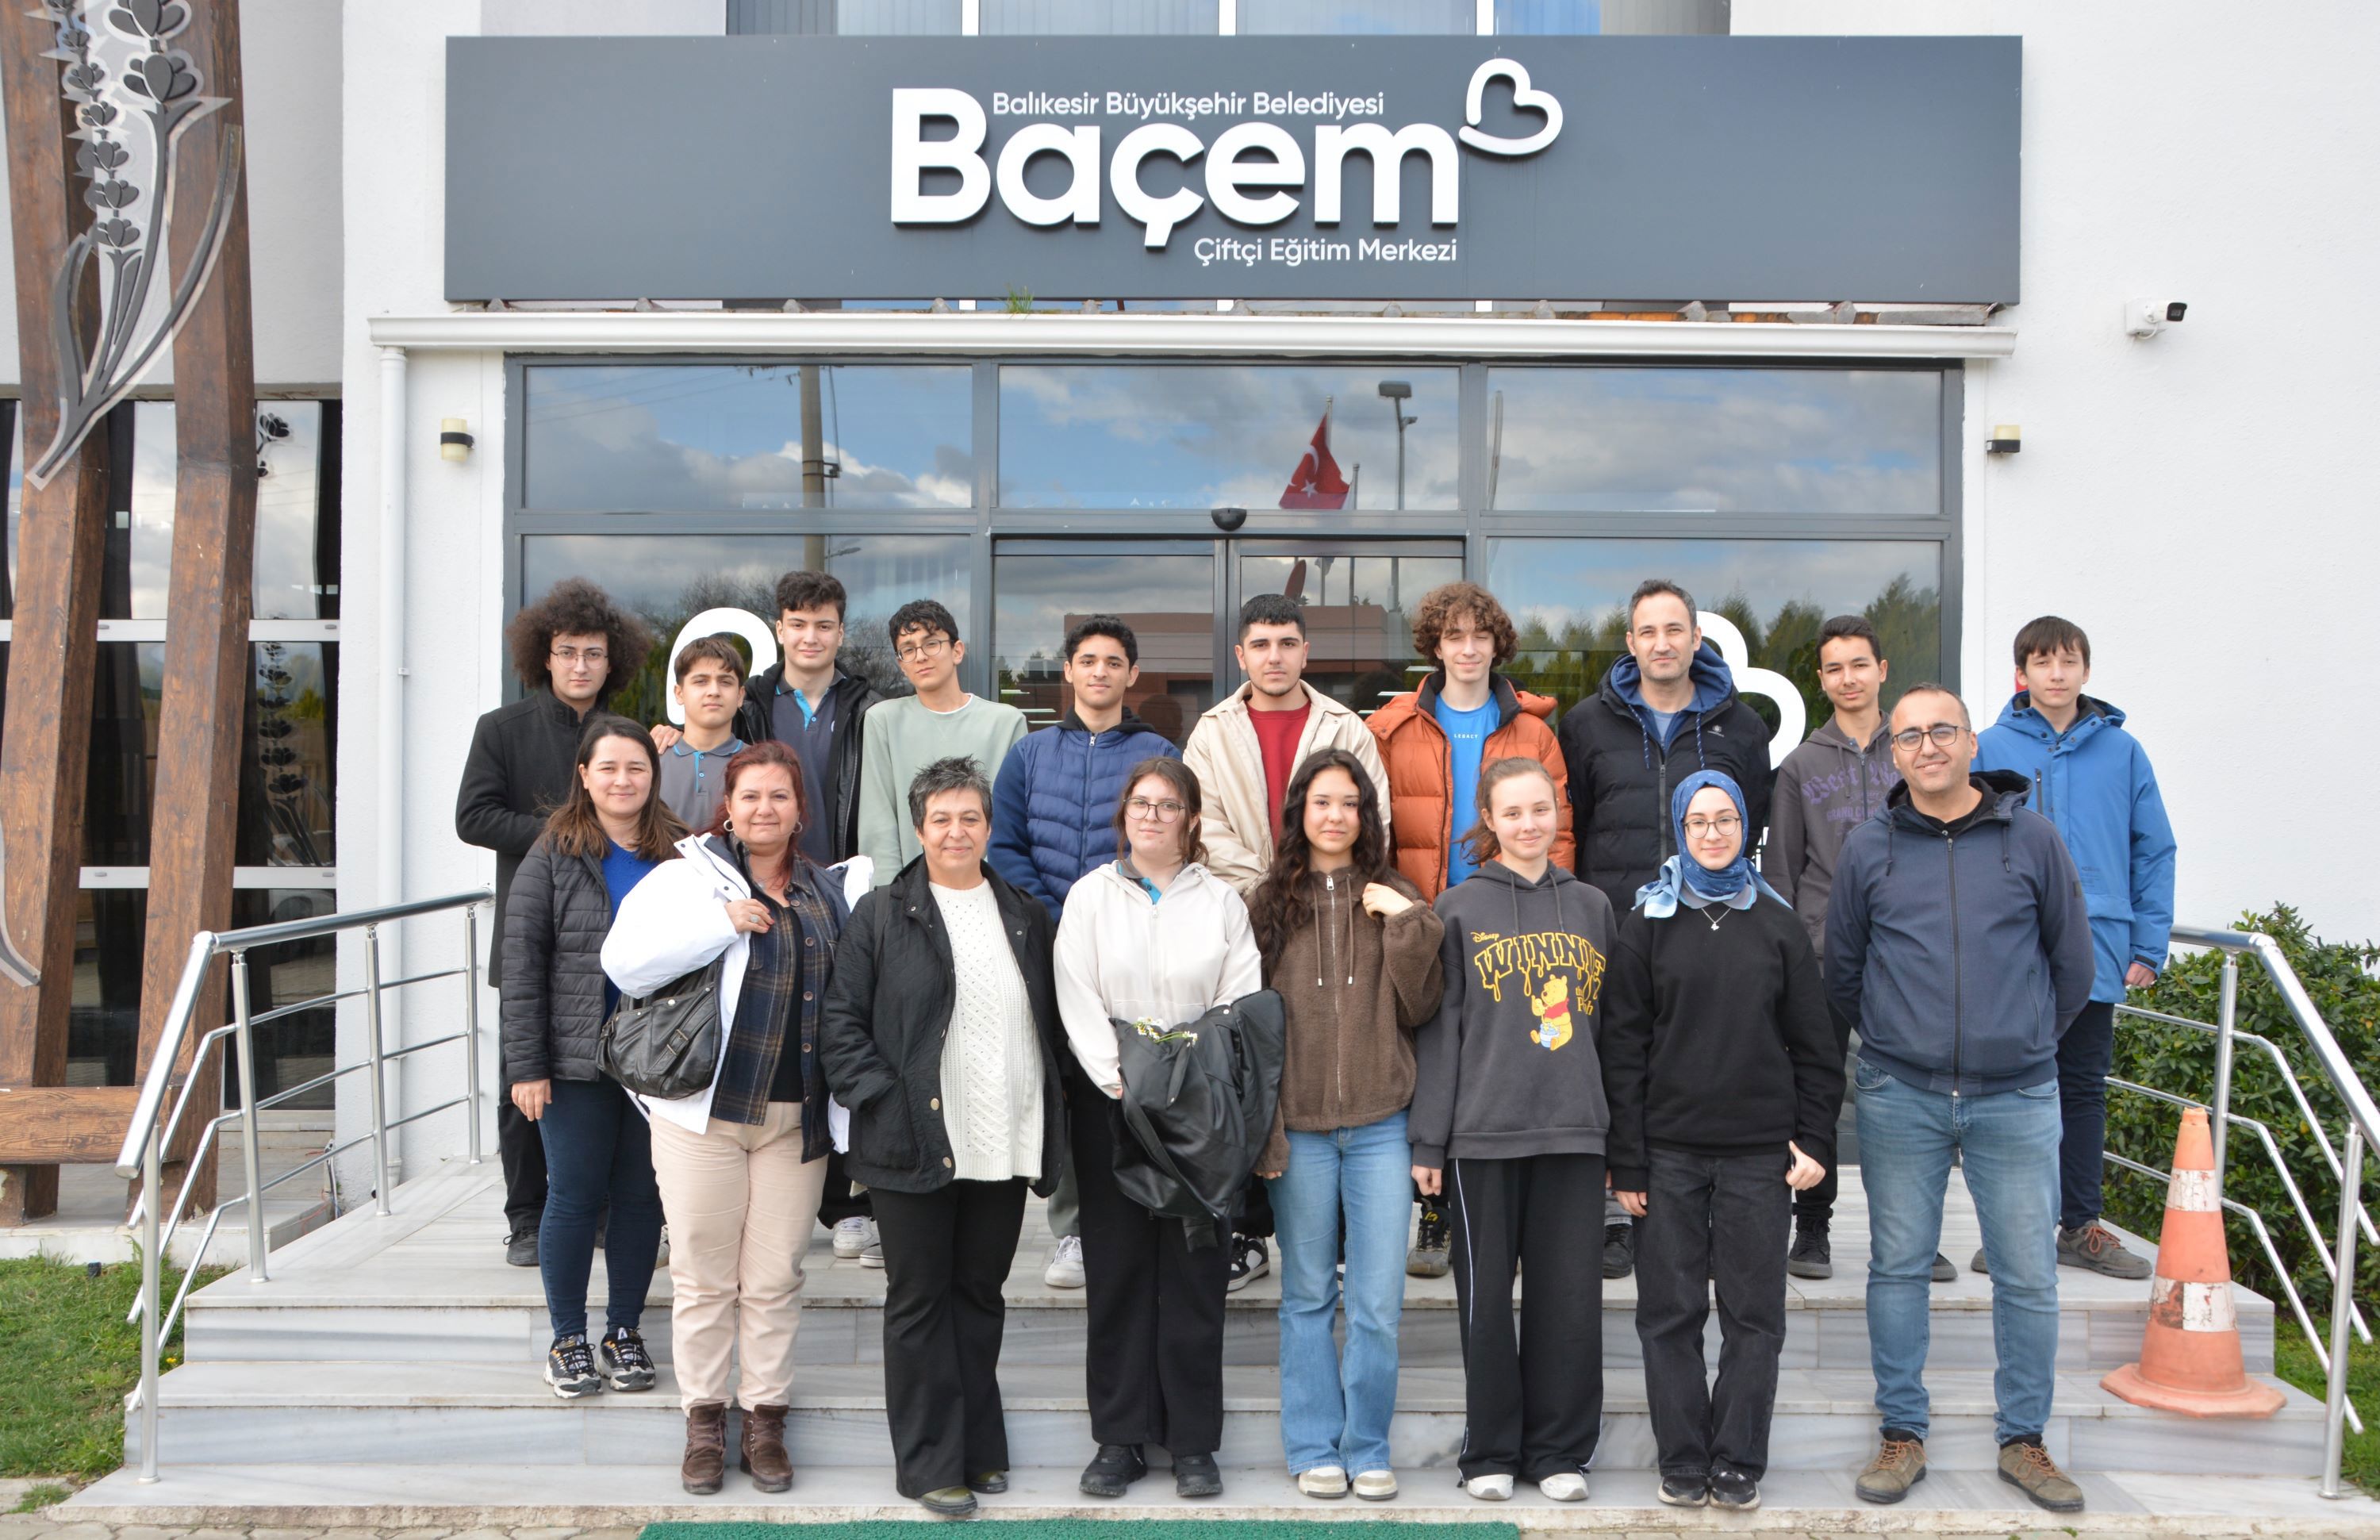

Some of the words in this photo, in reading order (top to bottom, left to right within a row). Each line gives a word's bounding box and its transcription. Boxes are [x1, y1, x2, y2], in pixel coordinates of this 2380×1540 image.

[992, 90, 1100, 115] Balıkesir
[1105, 90, 1247, 121] Büyükşehir
[1253, 90, 1384, 121] Belediyesi
[889, 86, 1460, 248] Baçem
[1193, 237, 1263, 267] Çiftçi
[1269, 237, 1351, 267] Eğitim
[1357, 237, 1457, 262] Merkezi
